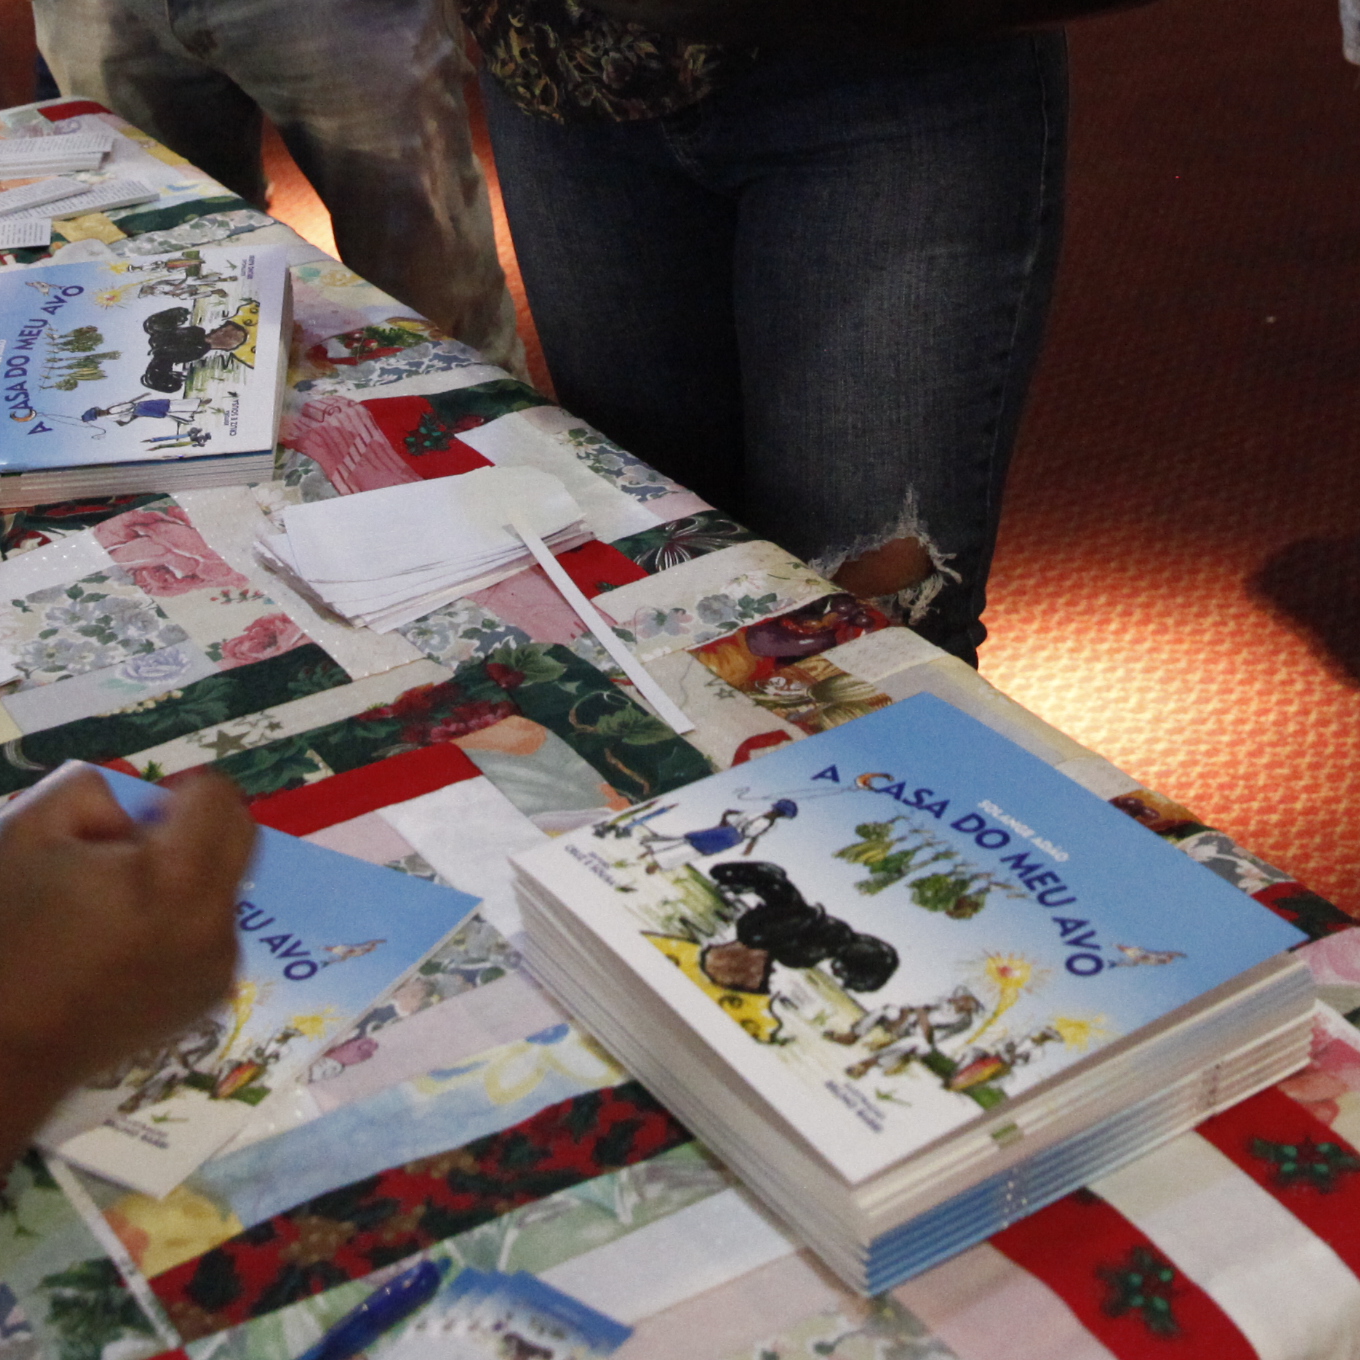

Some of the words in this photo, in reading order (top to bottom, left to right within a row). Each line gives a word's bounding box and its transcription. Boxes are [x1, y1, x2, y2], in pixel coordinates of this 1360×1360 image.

[13, 318, 48, 350] MEU
[4, 355, 30, 379] DO
[4, 380, 38, 422] CASA
[27, 421, 53, 435] A
[810, 764, 840, 783] A
[854, 772, 950, 819] CASA
[950, 812, 1010, 850] DO
[999, 851, 1077, 908] MEU
